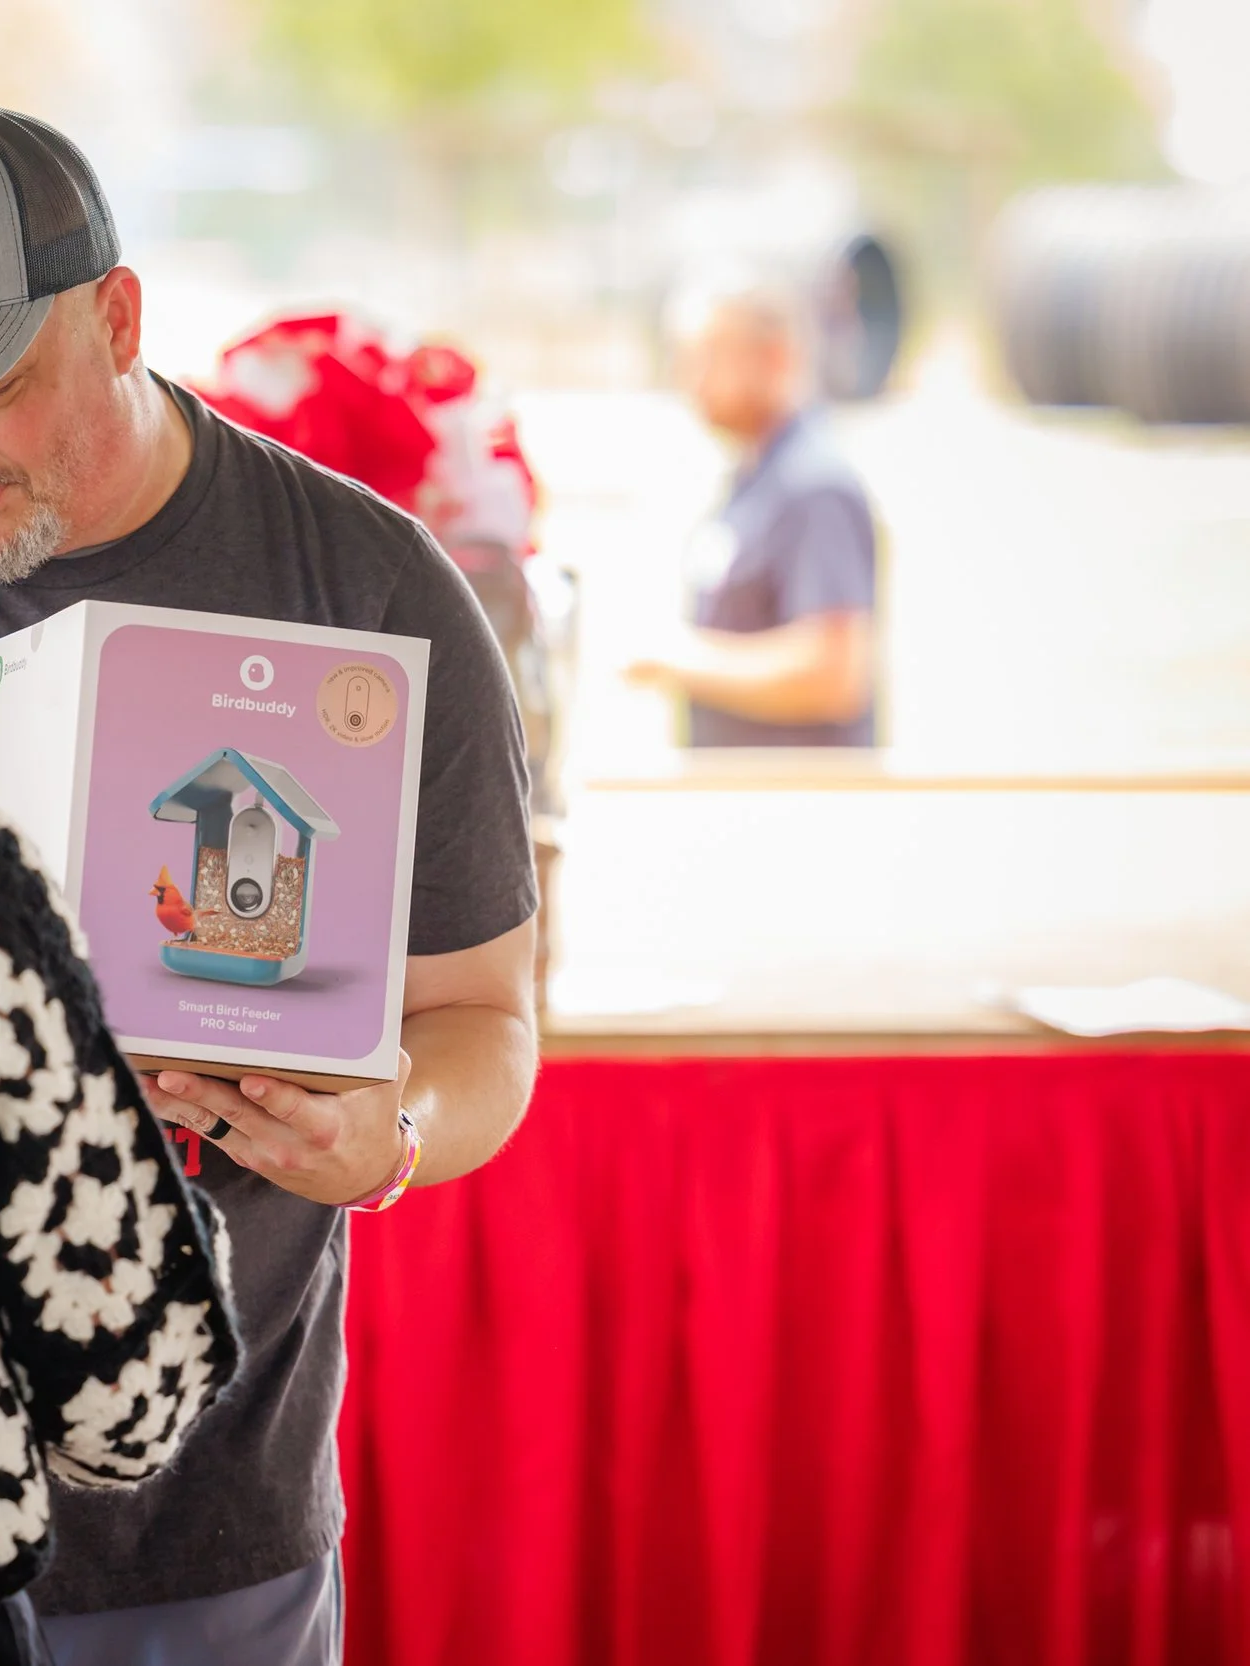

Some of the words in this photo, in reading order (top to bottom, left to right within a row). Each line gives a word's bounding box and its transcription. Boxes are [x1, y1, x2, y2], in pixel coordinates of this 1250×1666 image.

[344, 665, 374, 675] improved
[373, 672, 390, 693] camera
[211, 693, 296, 718] Birdbuddy
[337, 731, 353, 742] video
[374, 719, 390, 737] motion
[178, 1000, 214, 1014] Smart
[216, 1004, 239, 1017] Bird
[242, 1006, 282, 1021] Feeder
[200, 1017, 225, 1030] PRO
[227, 1020, 258, 1033] Solar
